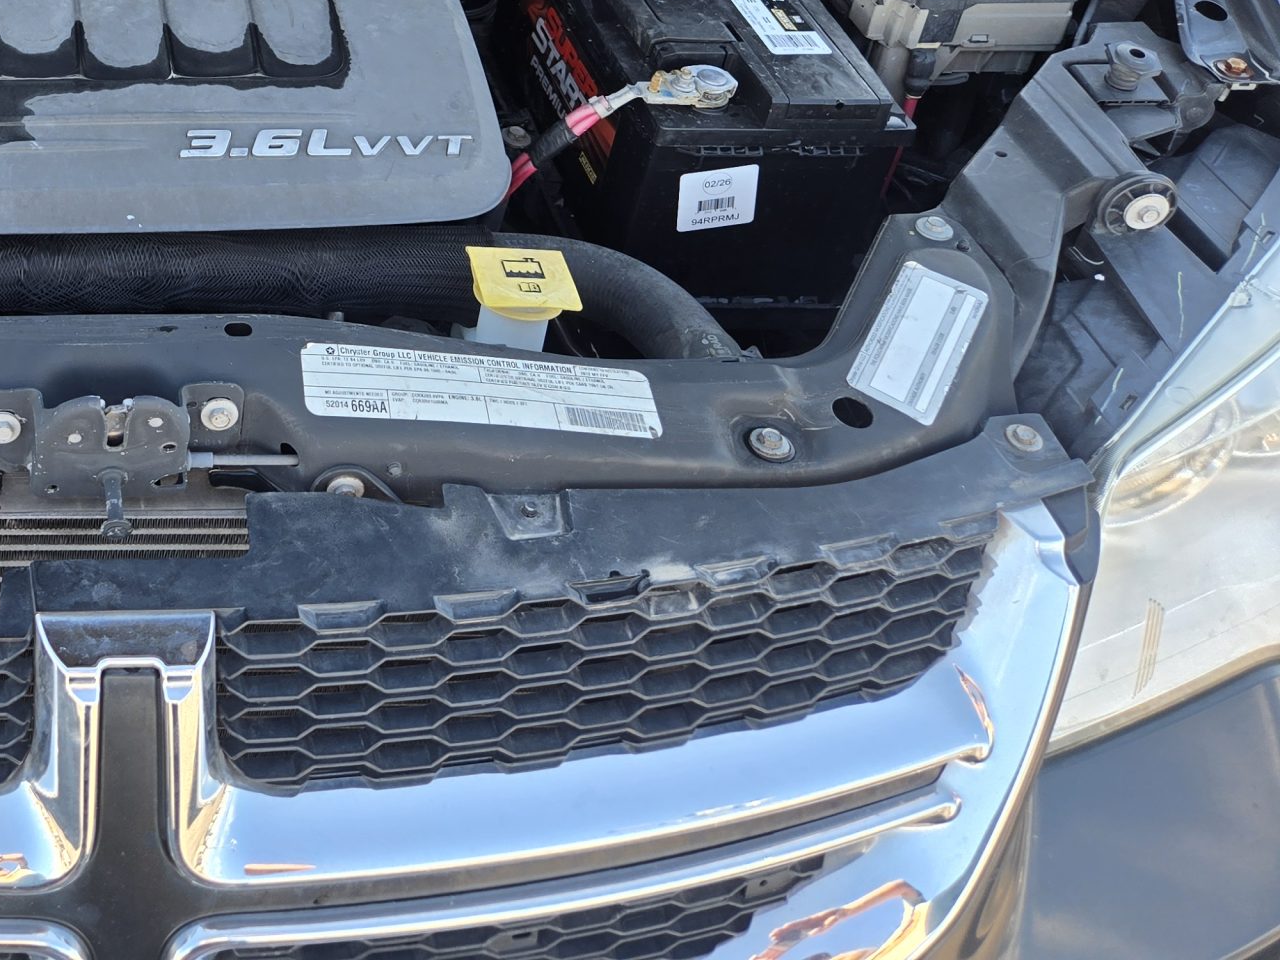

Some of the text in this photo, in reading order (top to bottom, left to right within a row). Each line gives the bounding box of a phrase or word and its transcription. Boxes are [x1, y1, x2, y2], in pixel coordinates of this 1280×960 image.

[546, 6, 598, 98] SUPER
[531, 17, 587, 111] START
[530, 54, 566, 120] PREMIU
[704, 178, 732, 189] 02/26
[691, 213, 740, 226] 94RPRMJ
[340, 347, 370, 358] Chrysler
[373, 349, 395, 359] Group
[418, 353, 447, 362] VEHICLE
[450, 356, 484, 366] EMISSION
[487, 359, 520, 368] CONTROL
[522, 362, 572, 373] INFORMATION
[325, 400, 388, 414] 52014 669AA
